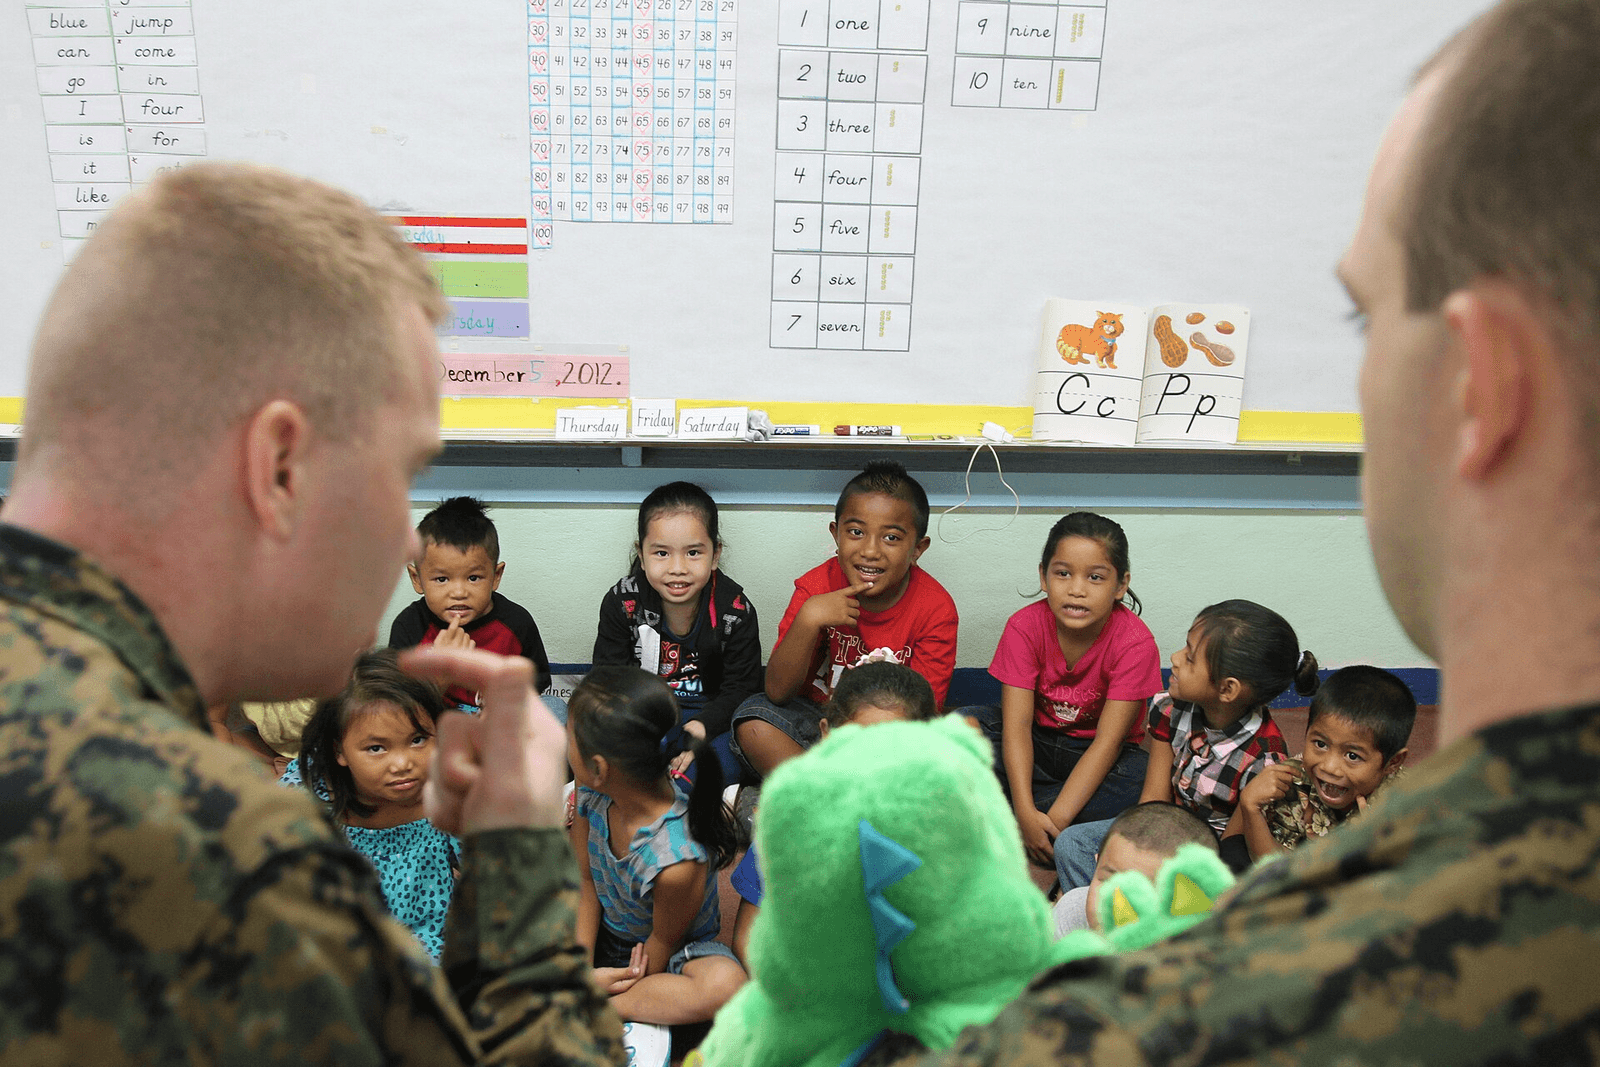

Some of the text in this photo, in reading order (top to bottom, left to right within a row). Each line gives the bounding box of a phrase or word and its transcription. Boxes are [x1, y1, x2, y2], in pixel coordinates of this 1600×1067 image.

[573, 0, 587, 8] 22
[594, 0, 608, 9] 23
[615, 0, 629, 9] 24
[636, 0, 650, 10] 25
[658, 0, 671, 10] 26
[678, 0, 693, 11] 27
[700, 0, 714, 12] 28
[721, 1, 734, 12] 29
[50, 13, 88, 29] blue
[125, 16, 174, 34] jump
[800, 10, 870, 31] 1 one
[978, 18, 1052, 39] 9 nine
[532, 25, 733, 42] 30 31 32 33 34 35 36 37 38 39
[57, 46, 90, 58] can
[134, 47, 176, 58] come
[532, 55, 732, 70] 40 41 42 43 44 45 46 47 48 49
[148, 74, 168, 86] in
[796, 64, 866, 84] 2 two
[968, 72, 1038, 90] 10 ten
[66, 76, 86, 94] go
[532, 84, 732, 100] 50 51 52 53 54 55 56 57 58 59
[78, 100, 88, 116] I
[140, 98, 184, 116] four
[533, 113, 731, 129] 60 61 62 63 64 65 66 67 68 69
[796, 116, 871, 134] 3 three
[78, 134, 94, 146] is
[152, 131, 180, 147] for
[534, 143, 731, 157] 70 71 72 73 74 75 76 77 78 79
[83, 162, 97, 176] it
[794, 168, 868, 186] 4 four
[534, 171, 730, 186] 80 81 82 83 84 85 86 87 88 89
[76, 187, 110, 204] like
[535, 200, 729, 214] 90 91 92 93 94 95 96 97 98 99
[535, 227, 550, 238] 100
[792, 217, 860, 237] 5 five
[790, 268, 857, 287] 6 six
[451, 308, 495, 334] rsday
[786, 314, 860, 333] 7 seven
[528, 360, 545, 382] 5
[560, 416, 620, 436] Thursday
[636, 409, 674, 432] Friday
[684, 415, 740, 435] Saturday
